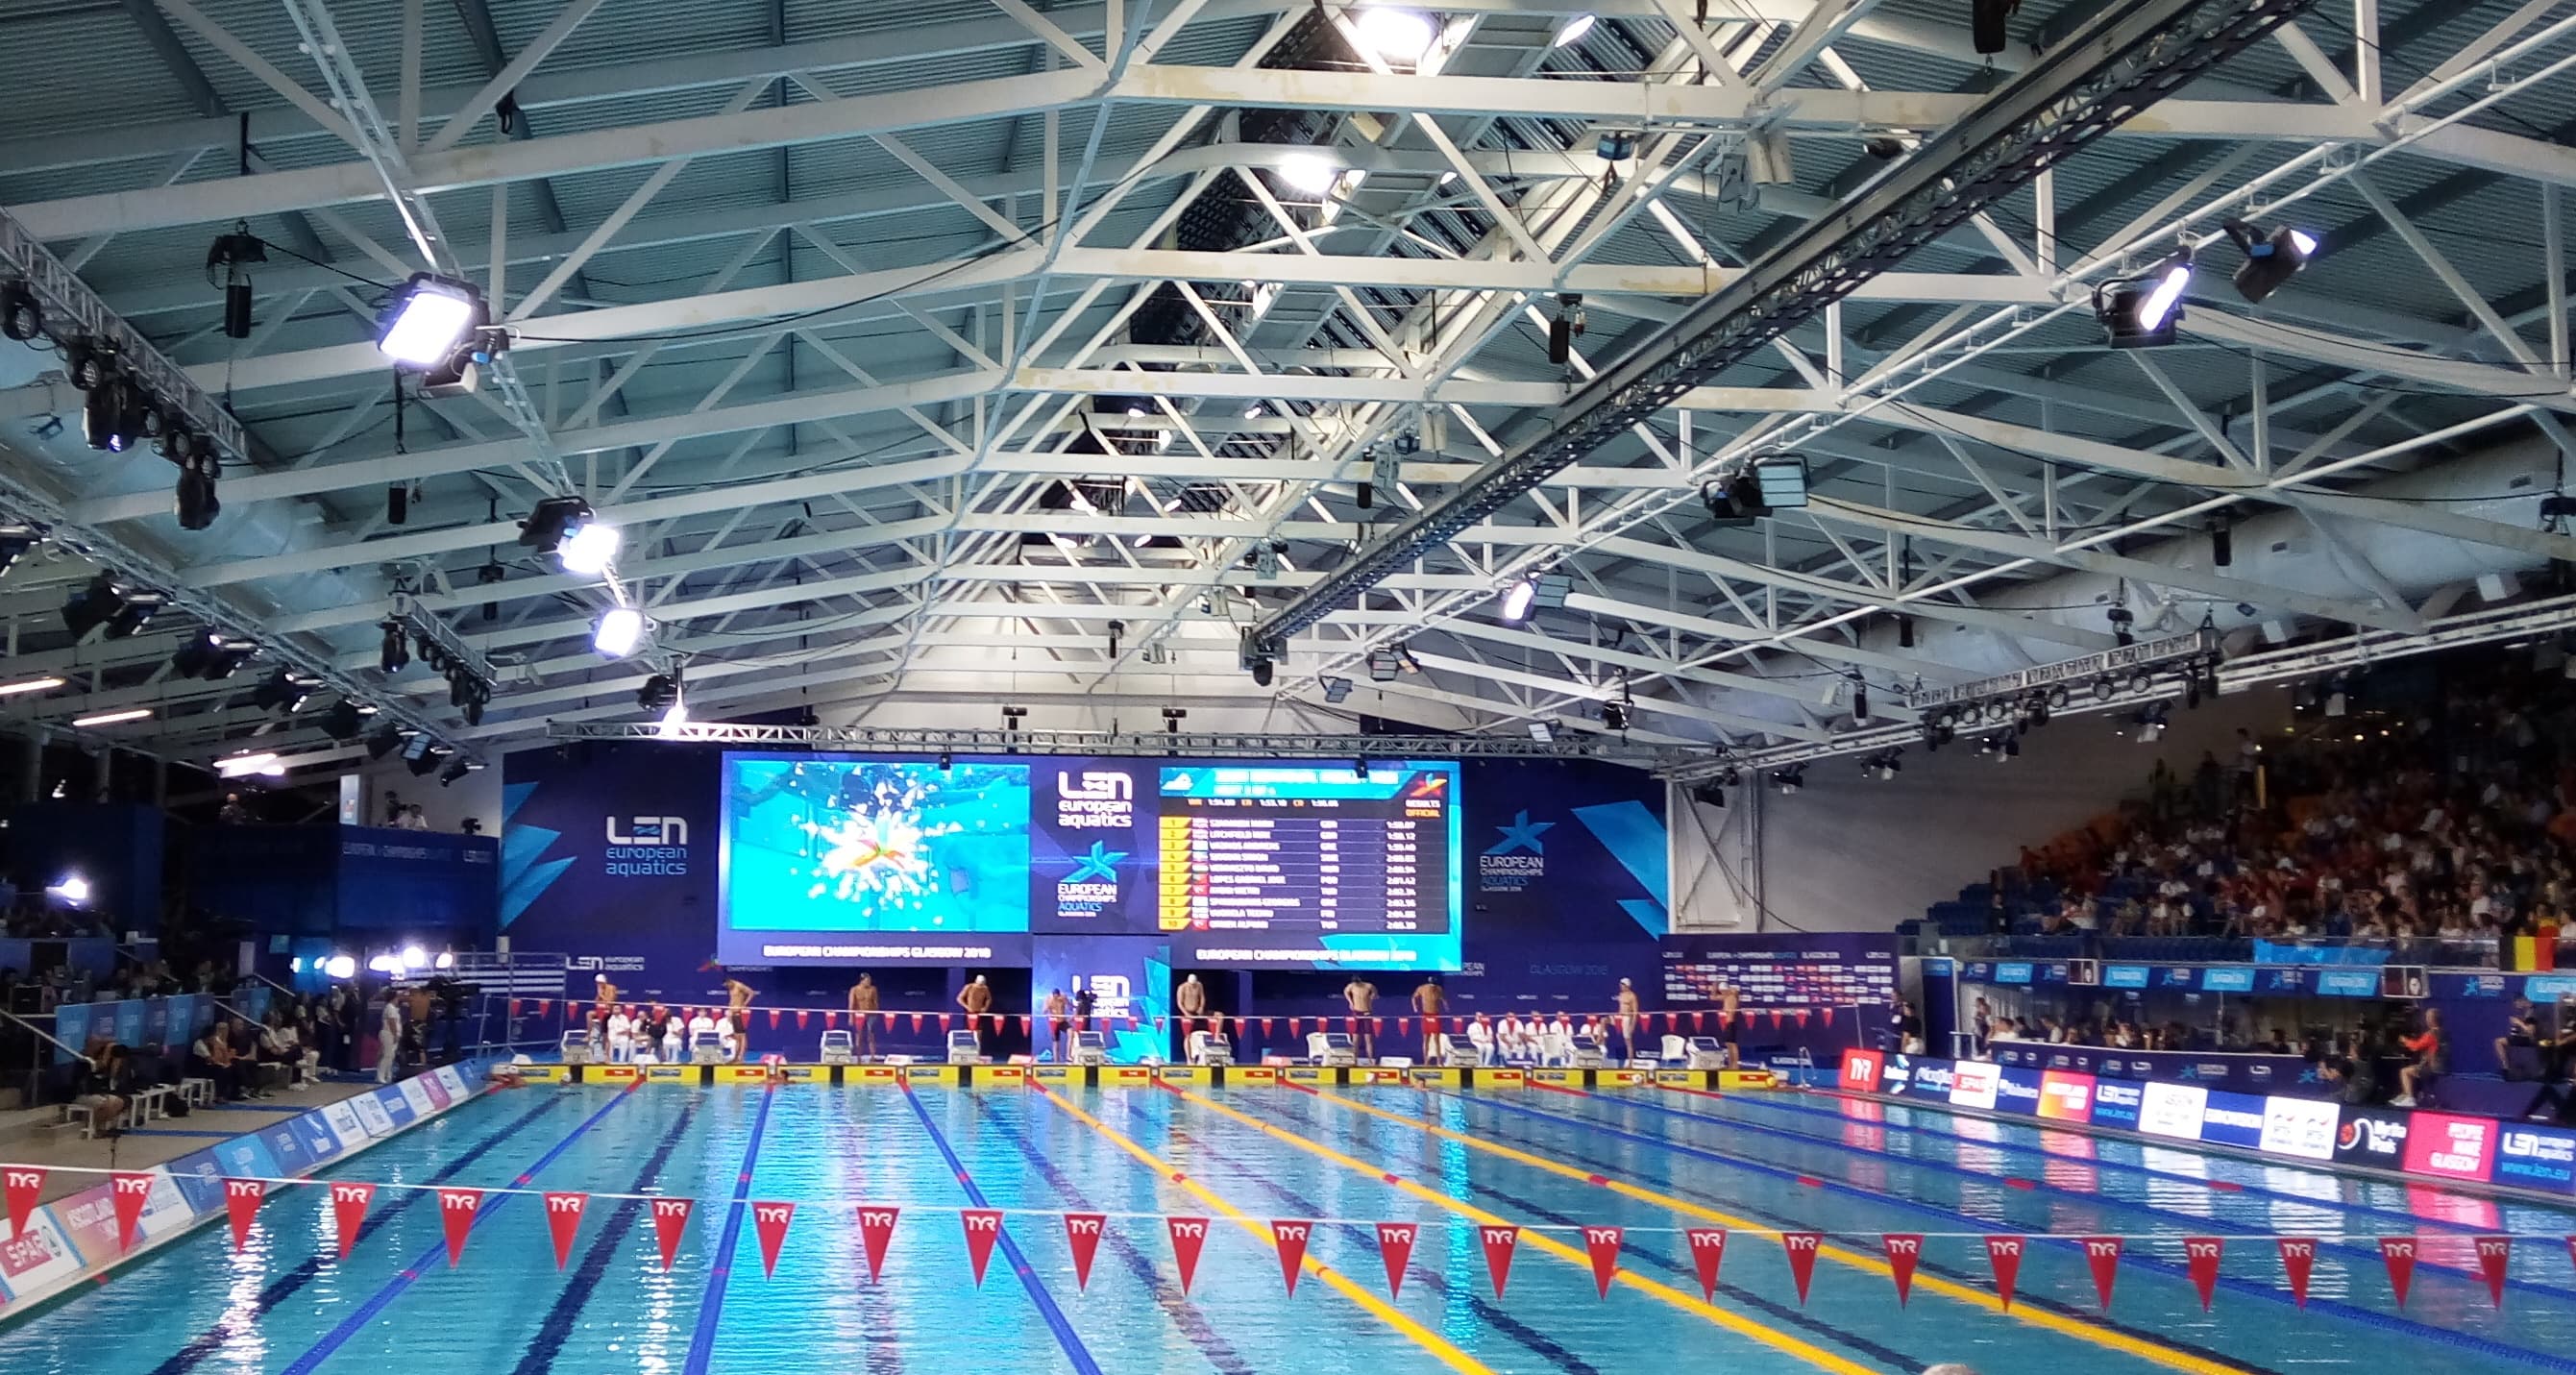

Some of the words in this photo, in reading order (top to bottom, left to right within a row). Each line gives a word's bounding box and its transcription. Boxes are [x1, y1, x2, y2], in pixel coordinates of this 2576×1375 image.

[1058, 800, 1132, 814] european
[1058, 813, 1132, 828] aquatics
[607, 817, 688, 845] LEN
[606, 847, 688, 861] european
[606, 860, 688, 877] aquatics
[1480, 856, 1543, 868] EUROPEAN
[1480, 868, 1544, 876] CHAMPIONSHIPS
[1481, 876, 1528, 886] AQUATICS
[1058, 884, 1117, 895] EUROPEAN
[1059, 902, 1103, 911] AQUATICS
[1196, 949, 1252, 959] EUROPEAN
[2430, 1152, 2481, 1172] GLASGOW
[2502, 1162, 2572, 1181] www.len.eu
[8, 1172, 40, 1189] TYR
[115, 1178, 147, 1194] TYR
[229, 1183, 260, 1196] TYR
[334, 1187, 369, 1204] TYR
[444, 1193, 477, 1210] TYR
[549, 1196, 581, 1213] TYR
[656, 1203, 686, 1216] TYR
[758, 1208, 788, 1223] TYR
[862, 1212, 893, 1227] TYR
[966, 1215, 996, 1233] TYR
[1069, 1219, 1099, 1235] TYR
[1172, 1222, 1203, 1239] TYR
[1277, 1226, 1306, 1240] TYR
[1382, 1228, 1411, 1244] TYR
[1484, 1230, 1513, 1244] TYR
[1588, 1229, 1617, 1244] TYR
[1692, 1232, 1721, 1247] TYR
[1788, 1236, 1816, 1250] TYR
[1888, 1240, 1916, 1253] TYR
[6, 1234, 48, 1268] SPAR
[1991, 1241, 2019, 1255] TYR
[2088, 1241, 2118, 1257] TYR
[2189, 1243, 2218, 1258] TYR
[2283, 1242, 2312, 1258] TYR
[2384, 1243, 2413, 1258] TYR
[2479, 1242, 2508, 1257] TYR
